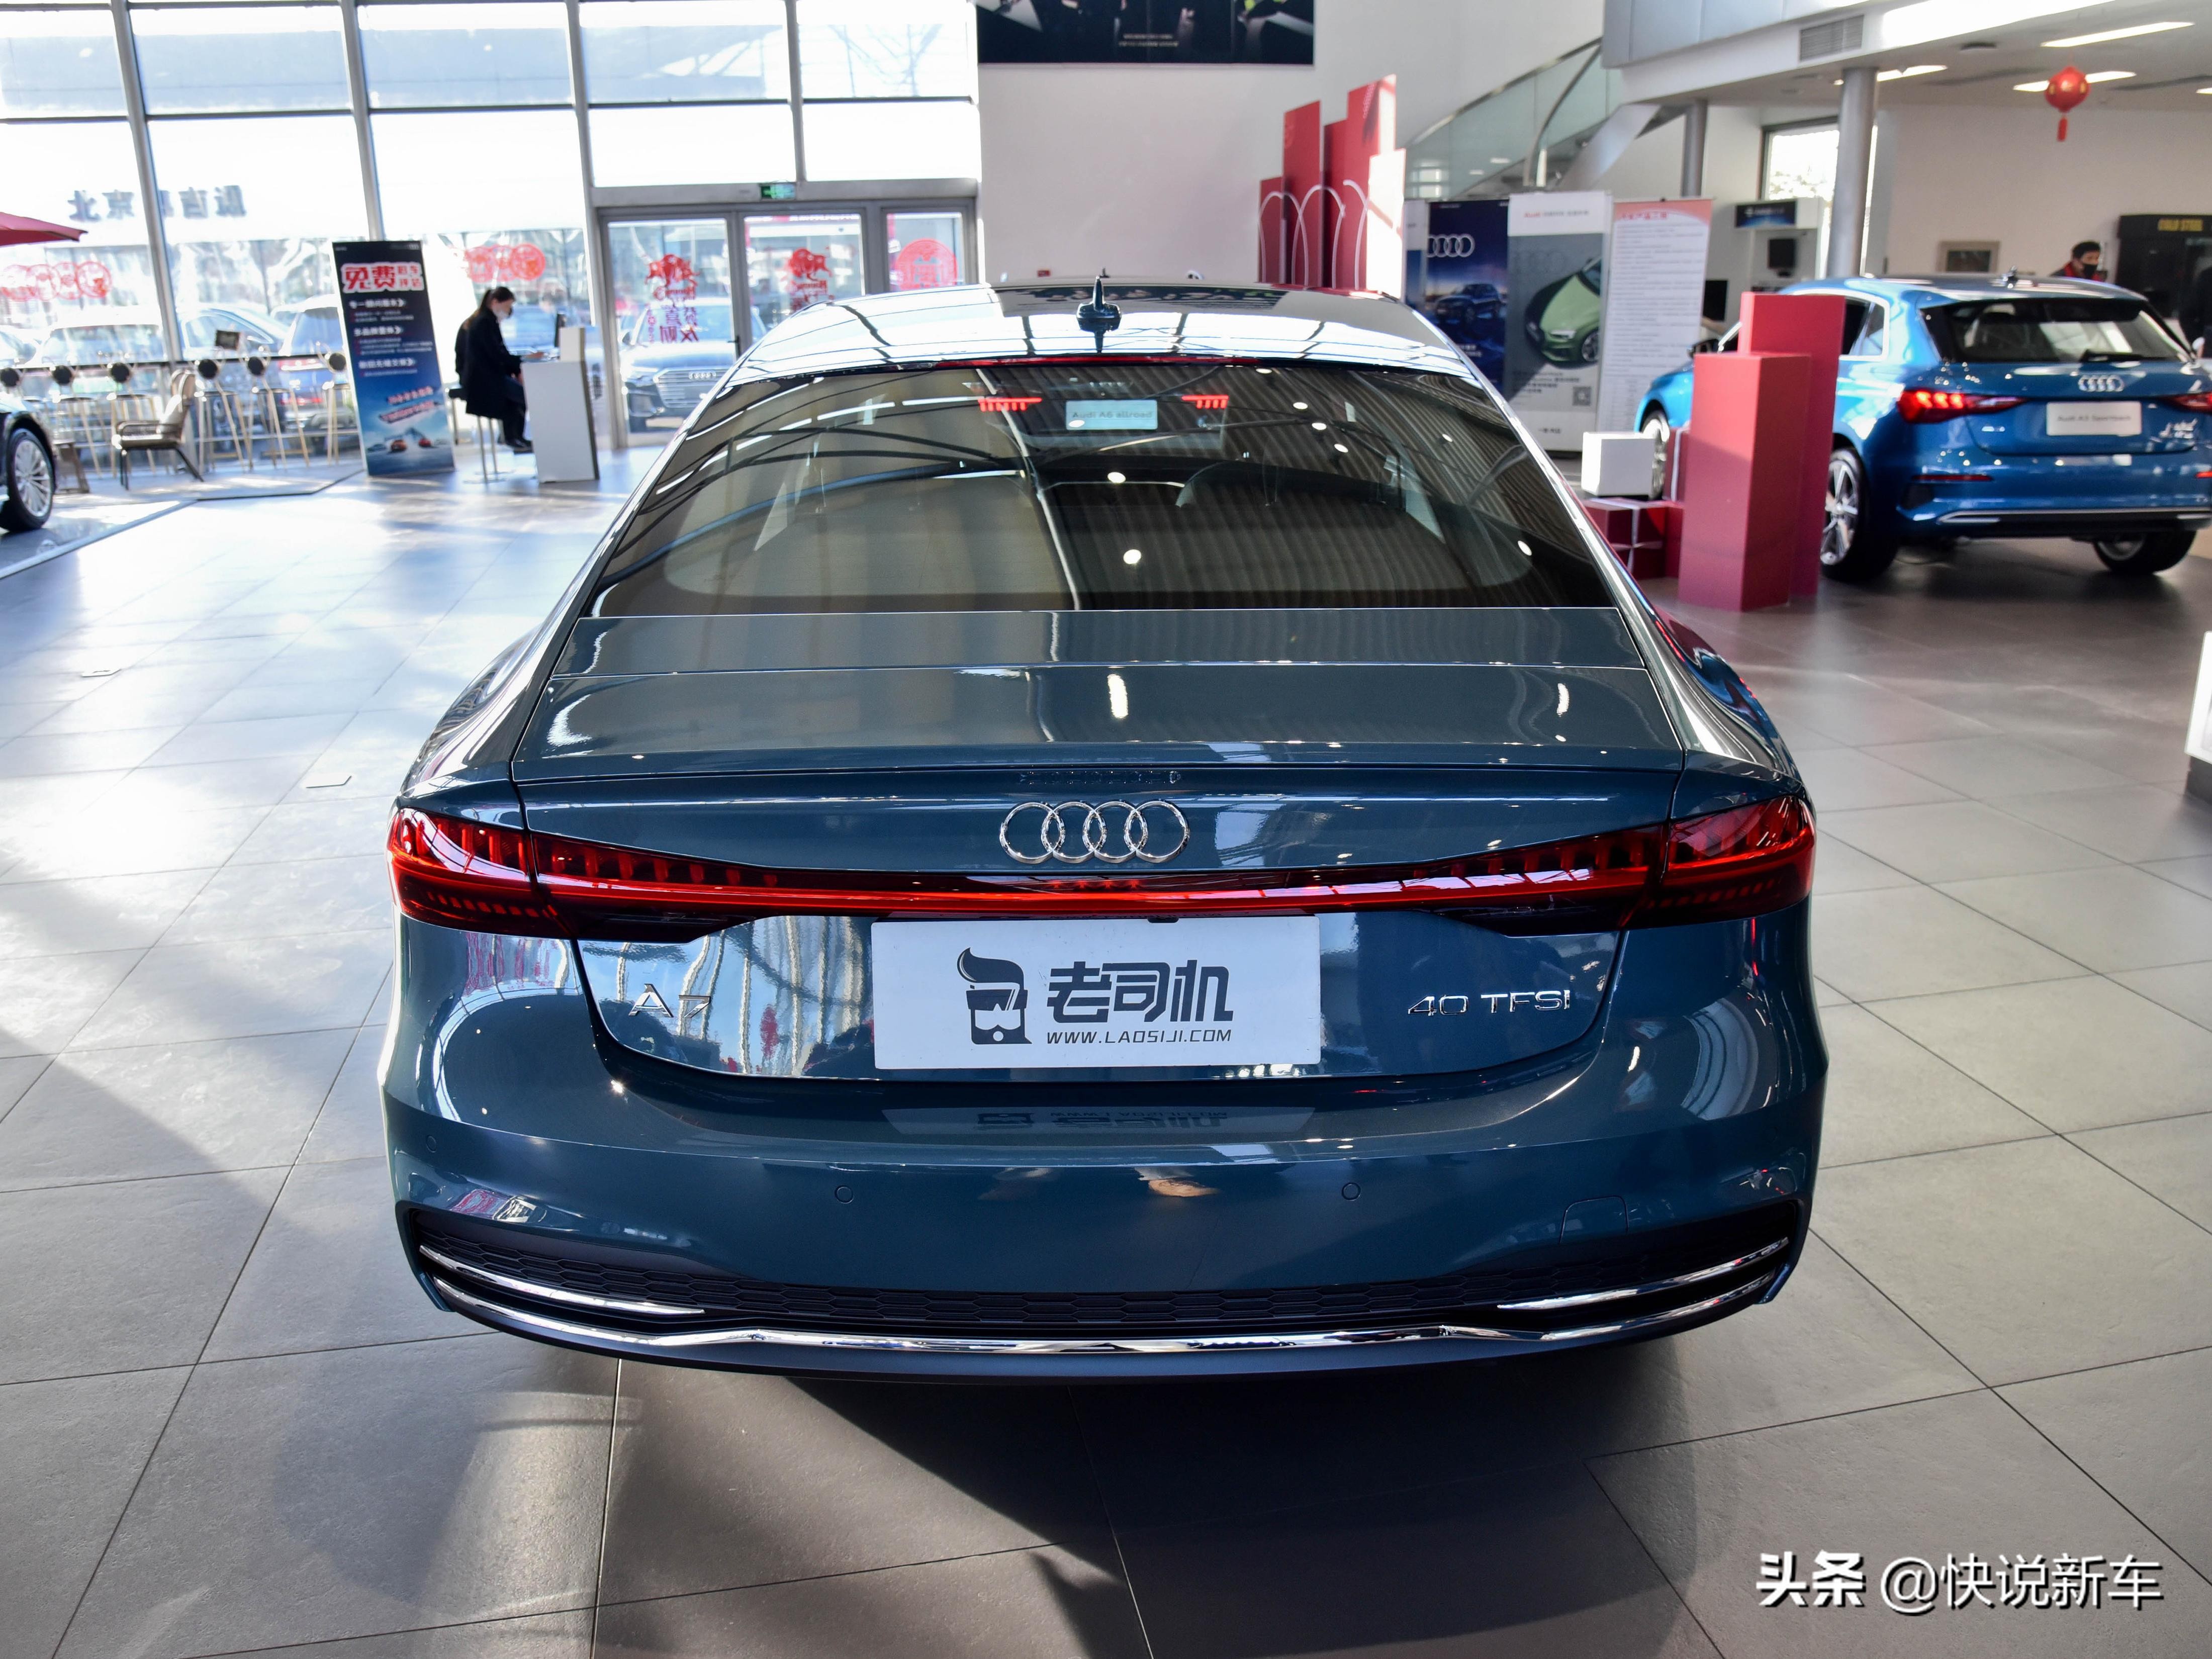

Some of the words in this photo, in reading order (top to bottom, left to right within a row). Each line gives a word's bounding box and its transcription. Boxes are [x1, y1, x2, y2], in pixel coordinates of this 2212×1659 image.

[345, 265, 396, 290] 免费
[628, 983, 710, 1018] A7
[1047, 960, 1233, 1023] 老司机
[1408, 994, 1468, 1016] 40
[1481, 989, 1570, 1013] TFSI
[1047, 1029, 1232, 1045] WWW.LAOSIJI.COM
